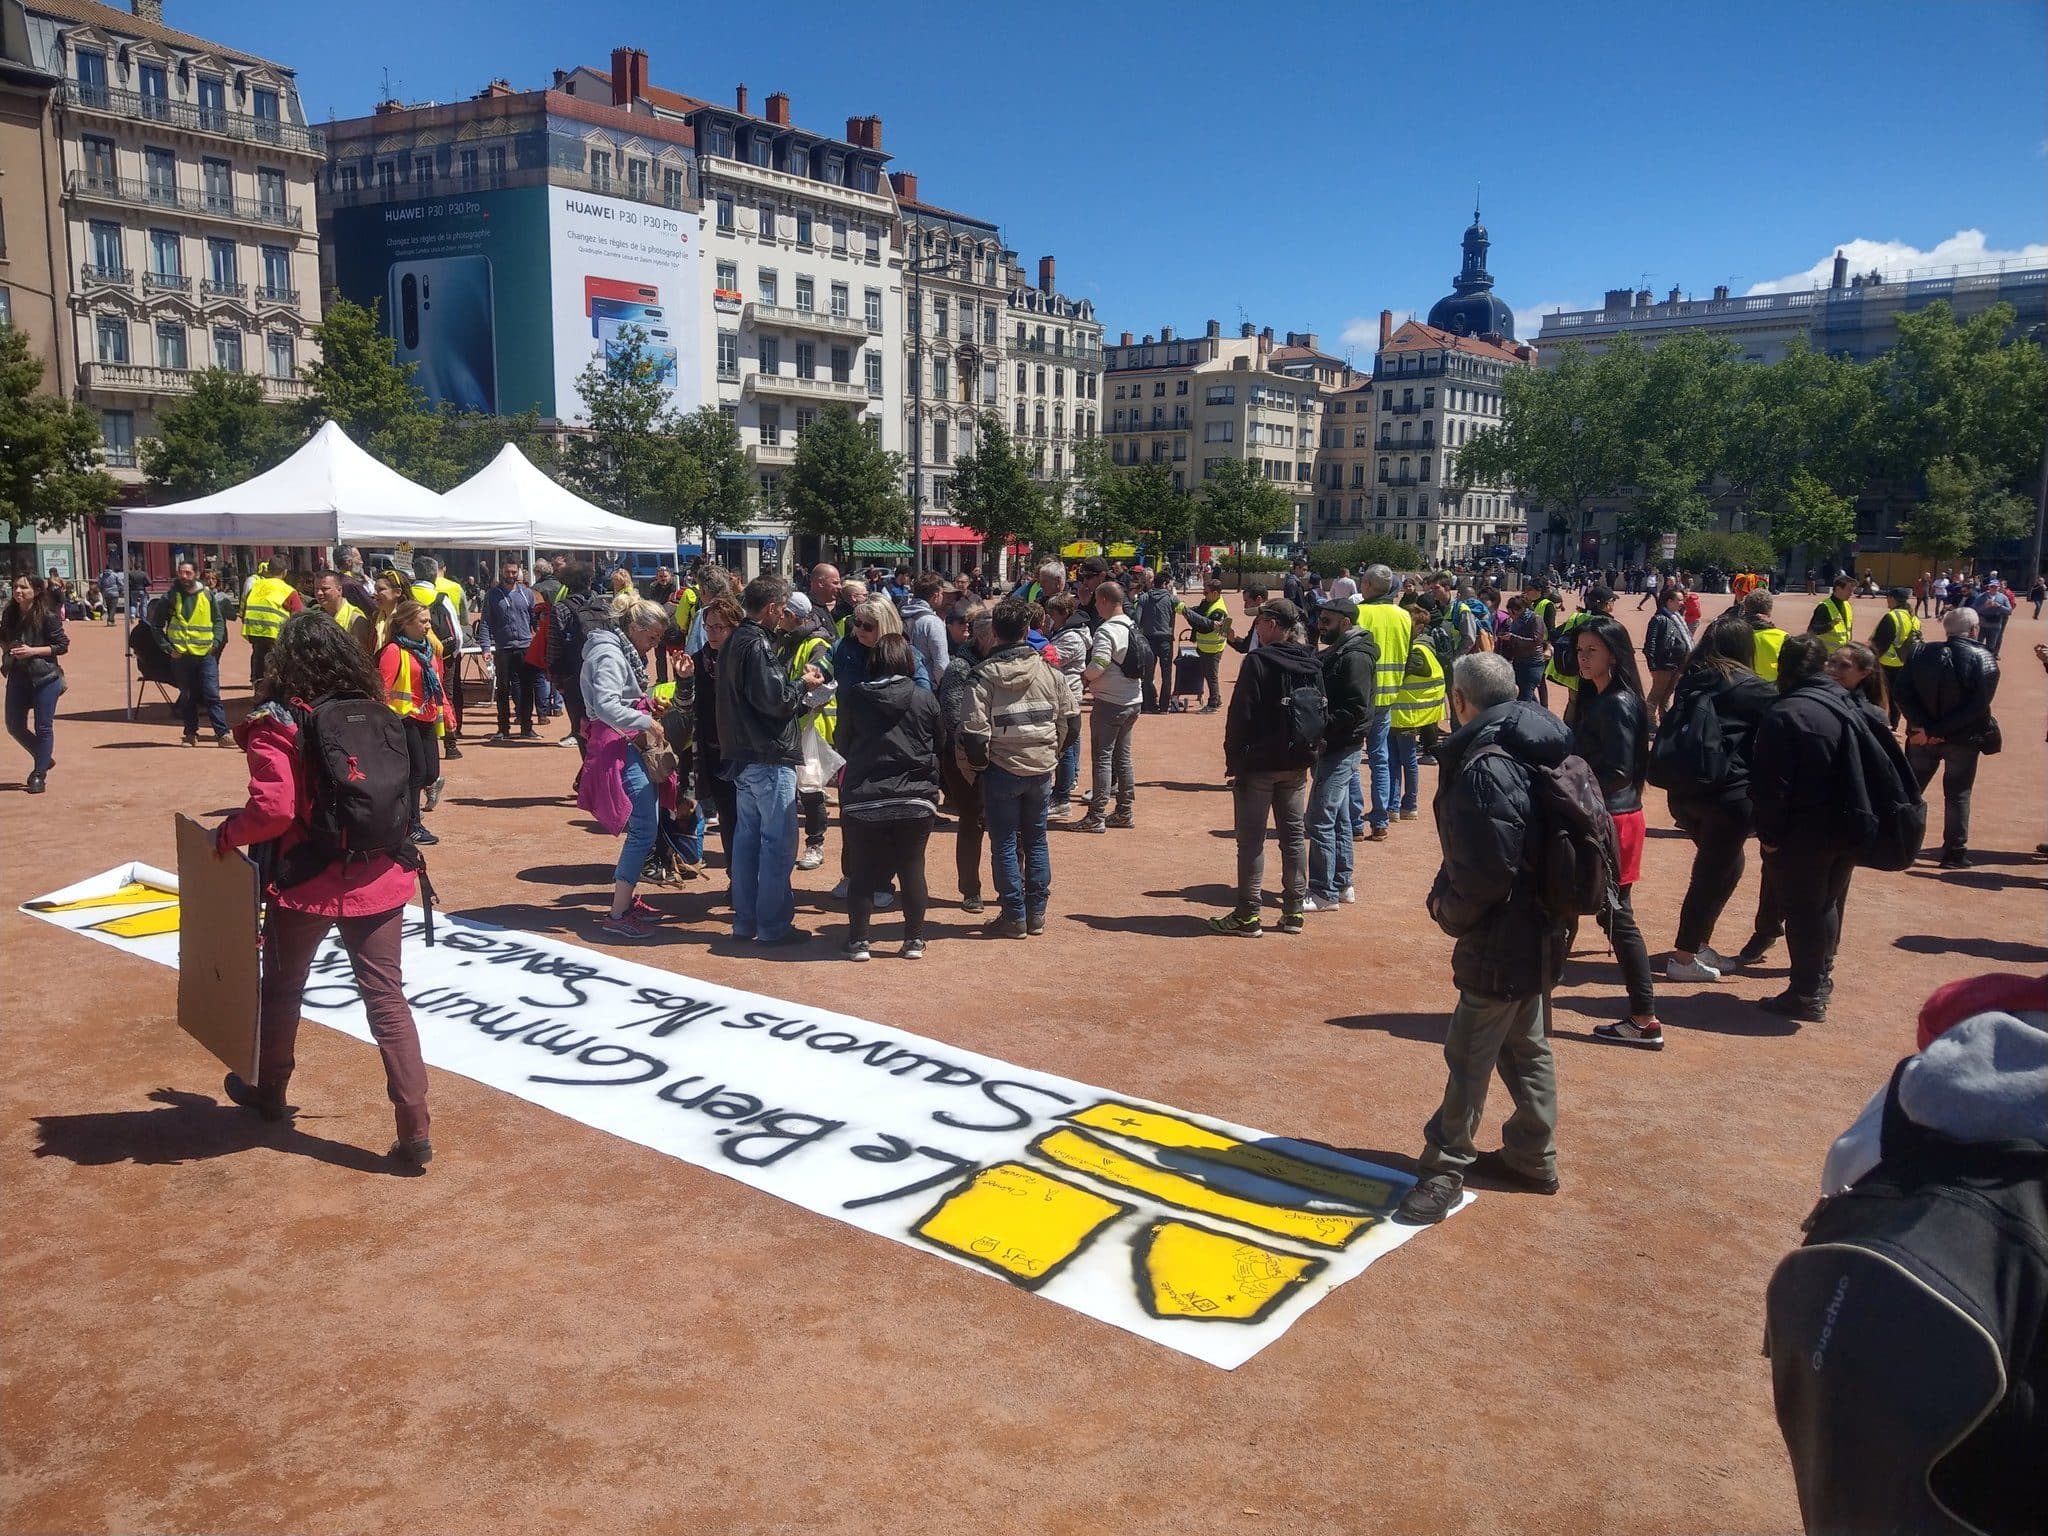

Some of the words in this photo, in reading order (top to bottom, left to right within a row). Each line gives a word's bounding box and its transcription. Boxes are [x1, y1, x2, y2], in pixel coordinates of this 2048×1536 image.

[385, 206, 424, 221] HUAWEI
[428, 205, 443, 217] P30
[449, 202, 464, 215] P30
[466, 201, 480, 213] Pro
[566, 199, 615, 220] HUAWEI
[619, 210, 637, 225] P30
[643, 215, 661, 229] P30
[663, 219, 678, 232] Pro
[567, 230, 596, 243] Changez
[599, 233, 608, 245] les
[630, 242, 639, 250] de
[640, 244, 646, 252] la
[647, 245, 689, 260] photographie
[406, 985, 669, 1088] Commun
[616, 988, 726, 1039] Nos
[720, 1010, 1075, 1132] Sauvons
[658, 1074, 847, 1167] Bien
[843, 1133, 981, 1209] Le
[1811, 1274, 1850, 1371] Quechua
